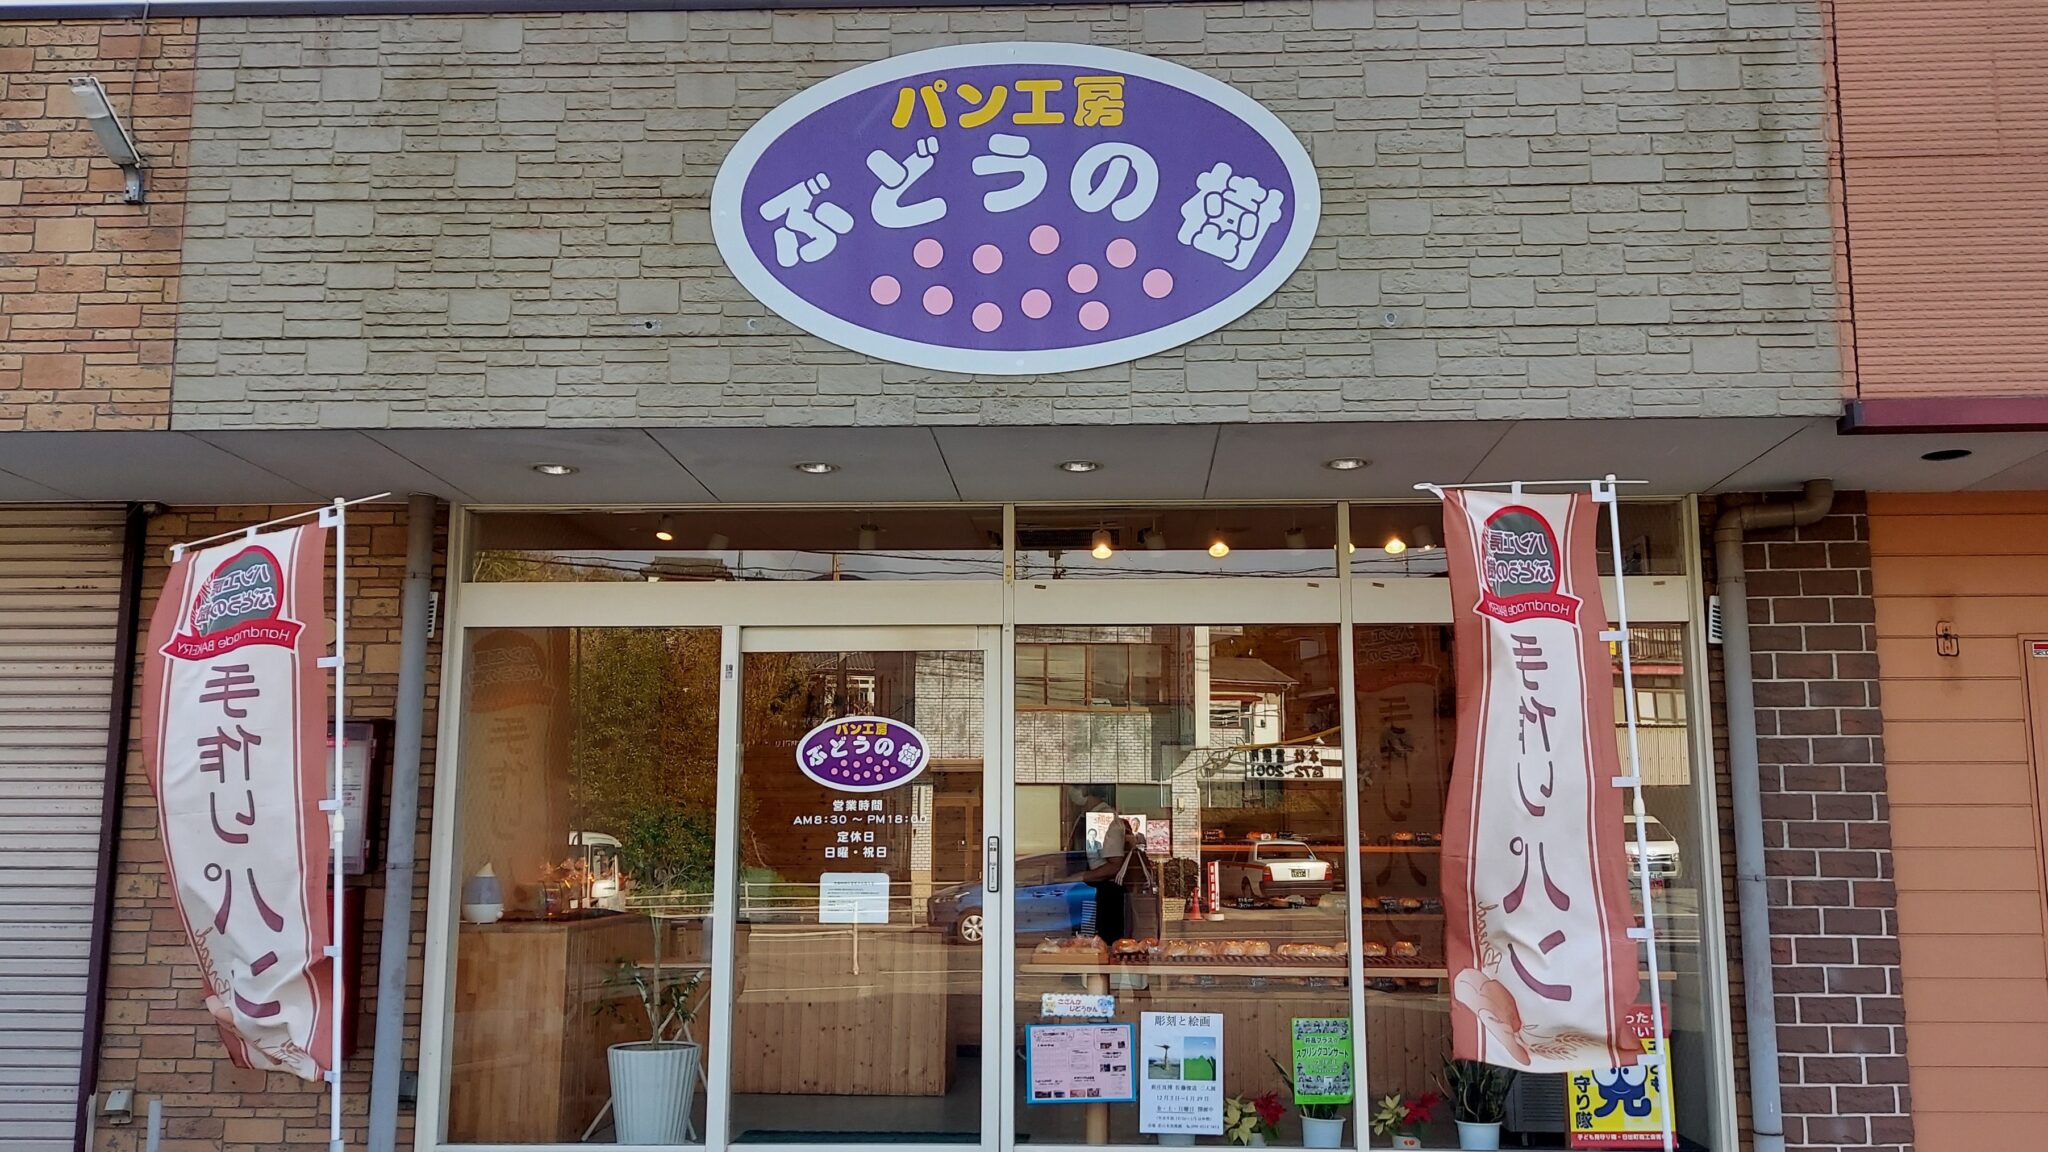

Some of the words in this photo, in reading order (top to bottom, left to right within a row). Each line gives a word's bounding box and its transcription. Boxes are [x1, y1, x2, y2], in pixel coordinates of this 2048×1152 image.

[891, 75, 1125, 129] パン工房
[758, 132, 1287, 272] ぶどうの樹
[835, 722, 888, 736] パン工房
[806, 735, 922, 769] ぶどうの樹
[832, 799, 883, 811] 営業時間
[793, 815, 847, 825] AM8:30
[867, 814, 928, 825] PM18:00
[837, 831, 874, 843] 定休日
[824, 846, 887, 859] 日曜・祝日
[1154, 1015, 1211, 1027] 彫刻と絵画
[1296, 1047, 1349, 1059] スプリングコンサート
[1574, 1075, 1593, 1129] 守り隊
